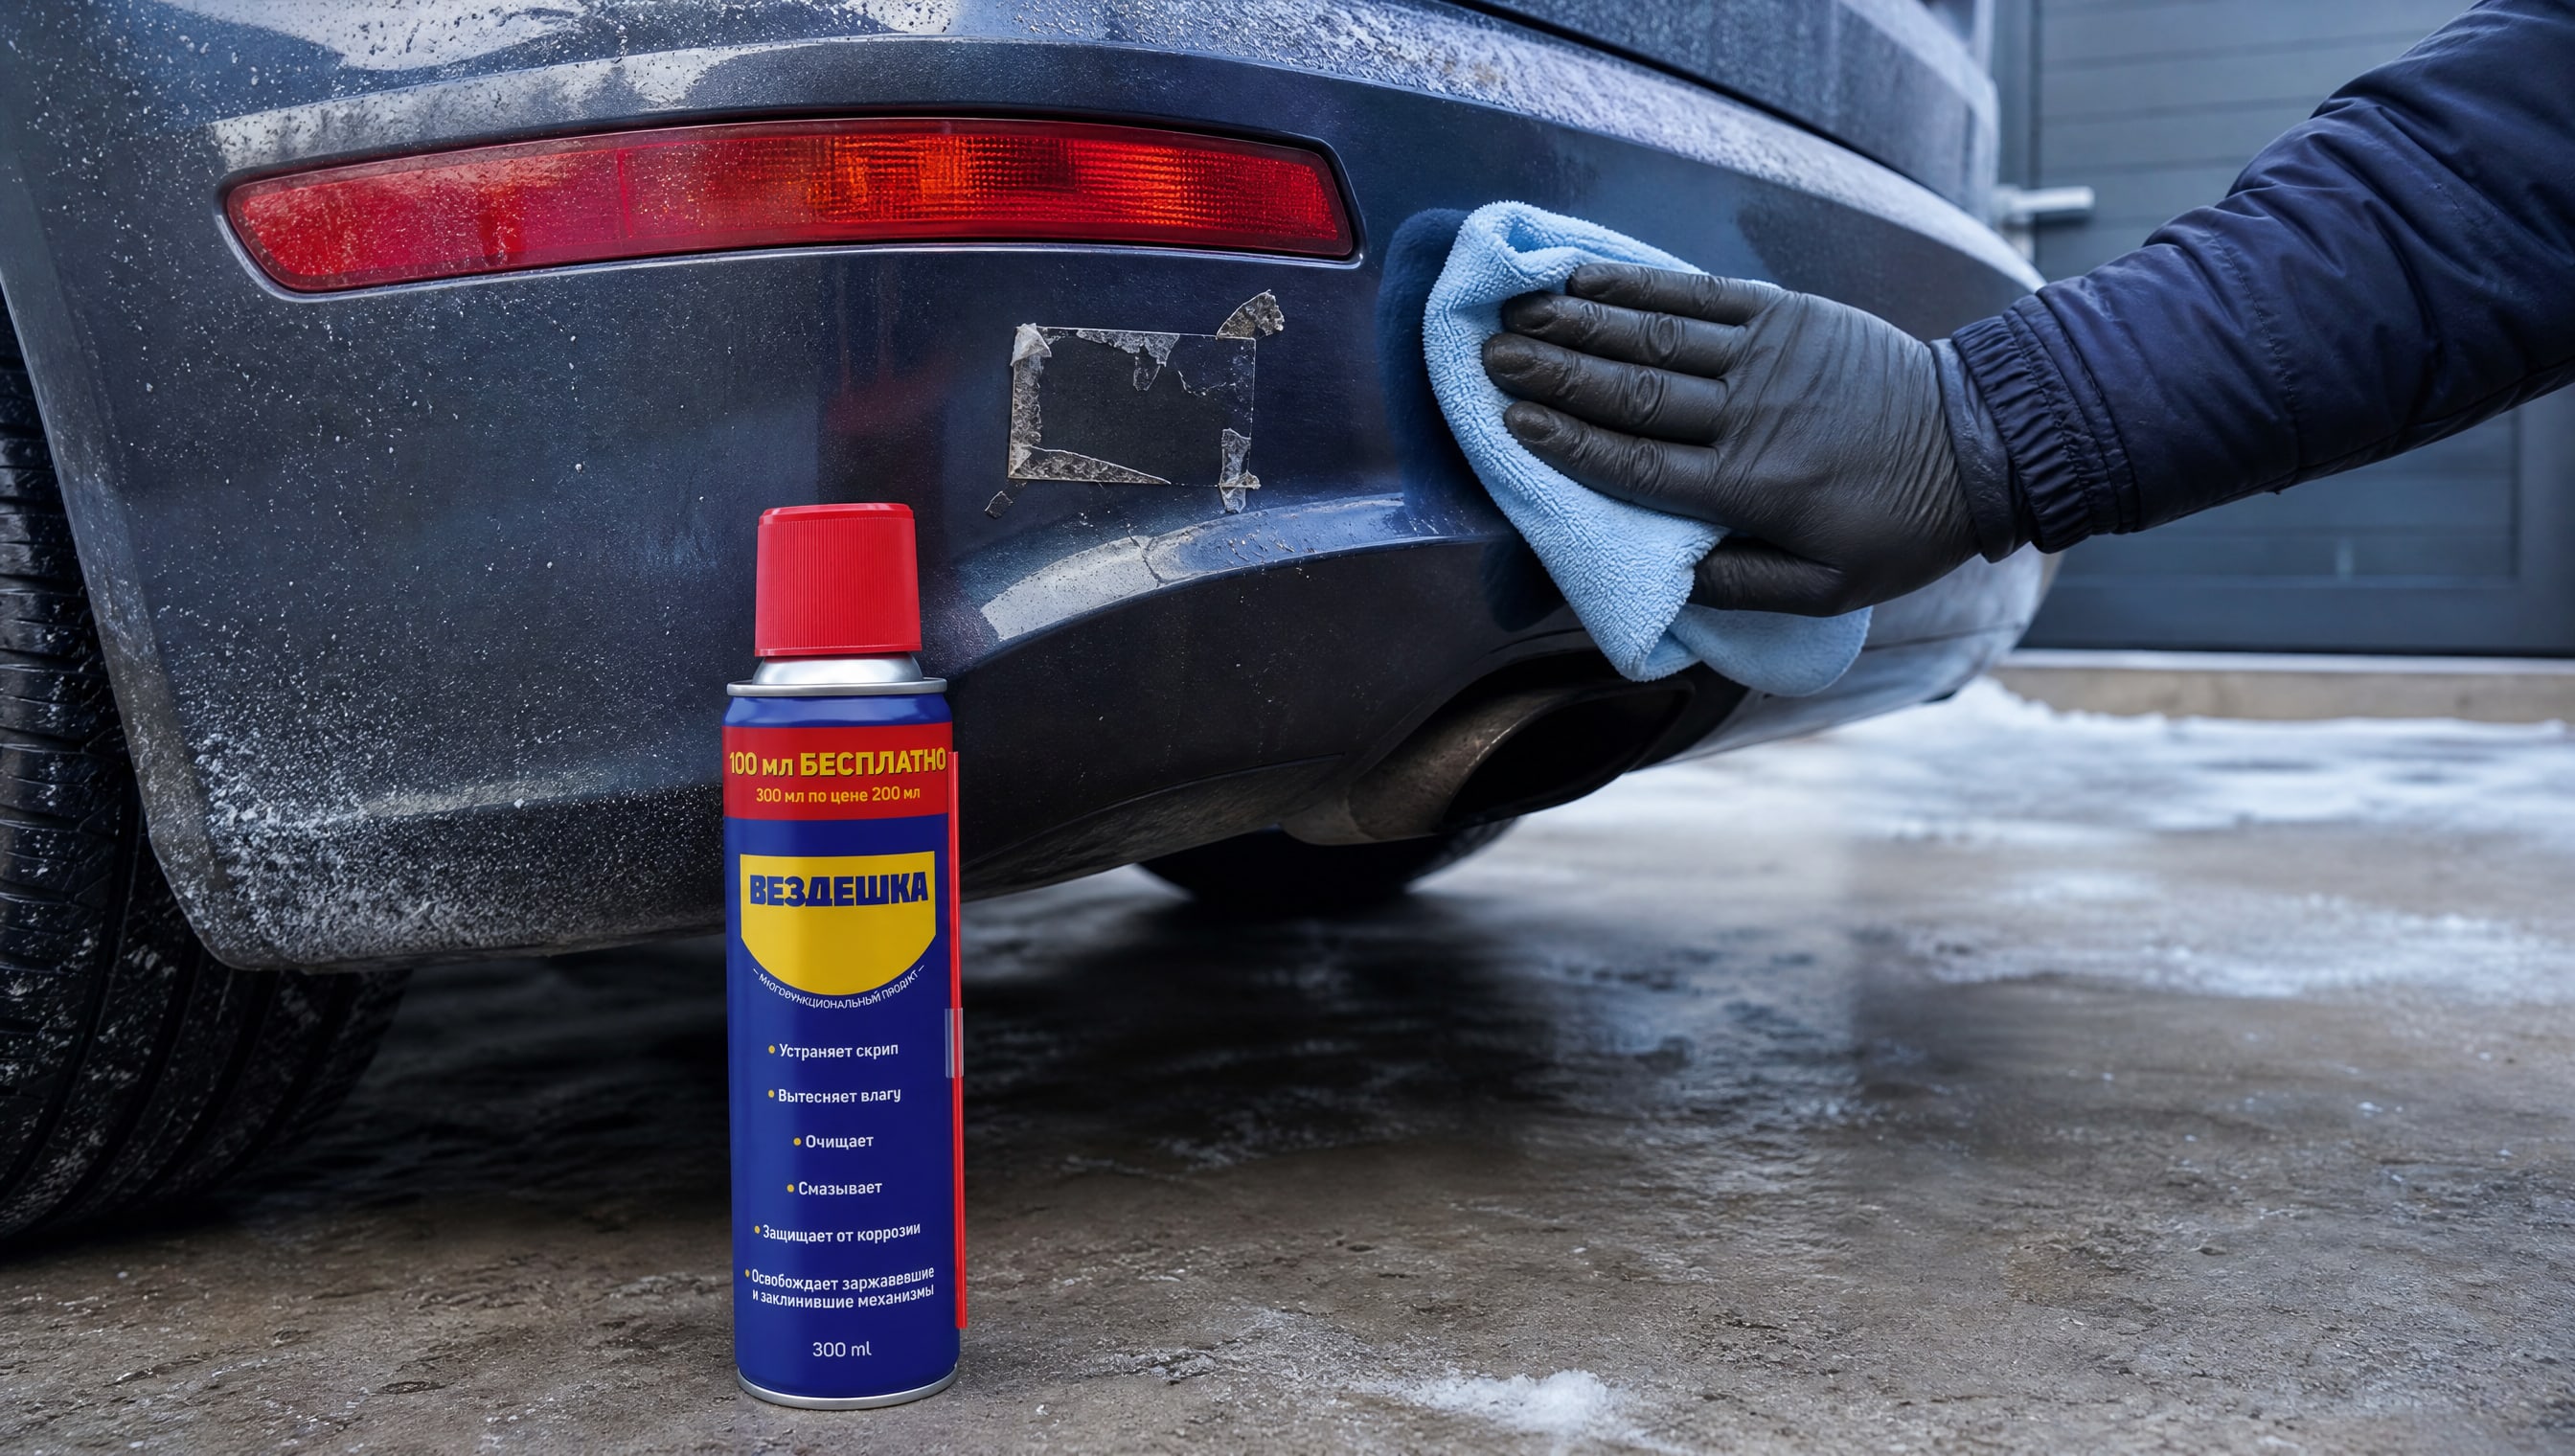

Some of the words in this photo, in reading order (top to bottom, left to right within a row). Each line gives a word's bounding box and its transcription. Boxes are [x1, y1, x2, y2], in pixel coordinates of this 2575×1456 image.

[729, 751, 758, 775] 100
[763, 758, 793, 776] мл
[800, 747, 946, 777] БЕСПЛАТНО
[756, 787, 782, 802] 300
[785, 790, 805, 803] мл
[809, 790, 827, 803] по
[831, 790, 868, 805] цене
[872, 786, 900, 801] 200
[903, 787, 921, 799] мл
[749, 872, 928, 907] ВЕЗДЕШКА
[779, 1043, 853, 1061] Устраняет
[856, 1044, 899, 1059] скрип
[779, 1089, 856, 1103] Вытесняет
[861, 1088, 900, 1103] влагу
[806, 1135, 874, 1149] Очищает
[798, 1181, 882, 1195] Смазывает
[763, 1224, 833, 1244] Защищает
[836, 1231, 854, 1242] от
[857, 1223, 921, 1244] коррозии
[752, 1269, 838, 1291] Освобождает
[842, 1266, 934, 1292] заржавевшие
[753, 1289, 758, 1301] и
[761, 1292, 854, 1308] заклинившие
[858, 1285, 934, 1308] механизмы
[813, 1342, 846, 1357] 300
[852, 1341, 872, 1356] ml
